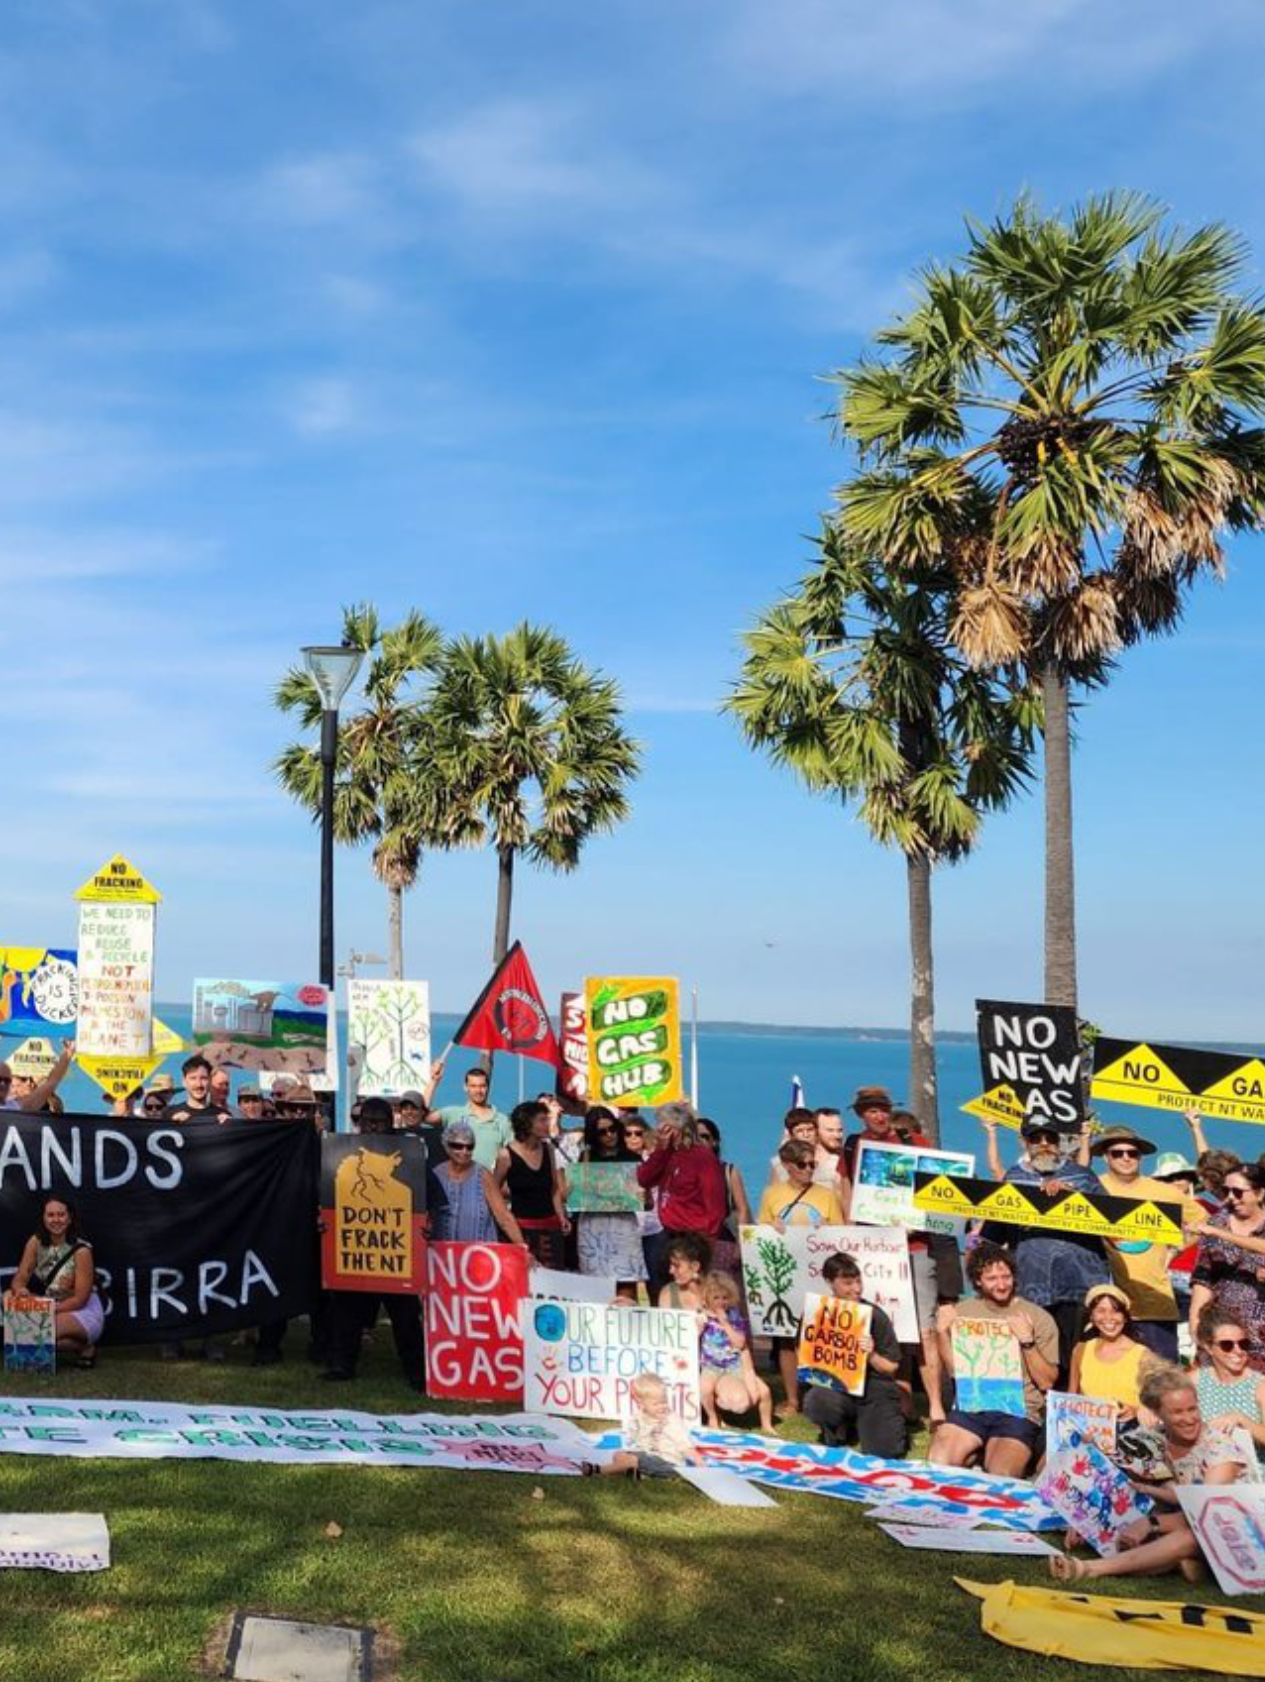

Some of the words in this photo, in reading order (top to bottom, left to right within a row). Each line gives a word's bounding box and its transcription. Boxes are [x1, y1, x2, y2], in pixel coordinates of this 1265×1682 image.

[94, 876, 143, 889] FRACKING
[110, 862, 127, 875] NO
[101, 965, 135, 977] NOT
[49, 984, 63, 998] IS
[603, 997, 649, 1026] NO
[992, 1014, 1058, 1049] NO
[28, 1040, 42, 1052] NO
[597, 1029, 659, 1067] GAS
[603, 1061, 663, 1098] HUB
[989, 1051, 1082, 1085] NEW
[1122, 1061, 1162, 1084] NO
[1232, 1077, 1265, 1099] GA
[997, 1090, 1014, 1103] NO
[1023, 1087, 1078, 1122] AS
[1156, 1093, 1215, 1113] PROTECT
[1218, 1100, 1237, 1115] NT
[341, 1206, 404, 1227] DON'T
[930, 1185, 955, 1199] NO
[996, 1193, 1022, 1209] GAS
[1063, 1203, 1091, 1218] PIPE
[1134, 1212, 1164, 1228] LINE
[952, 1205, 987, 1216] PROTECT
[341, 1229, 406, 1250] FRACK
[839, 1237, 860, 1252] Our
[341, 1251, 376, 1271] THE
[379, 1254, 407, 1273] NT
[427, 1244, 502, 1292] NO
[428, 1292, 525, 1340] NEW
[605, 1308, 689, 1349] FUTURE
[821, 1305, 853, 1331] NO
[429, 1342, 524, 1391] GAS
[567, 1344, 667, 1375] BEFORE
[813, 1347, 857, 1371] BOMB
[535, 1372, 606, 1413] YOUR
[187, 1412, 559, 1440] FUELLING
[114, 1428, 437, 1457] CRISIS
